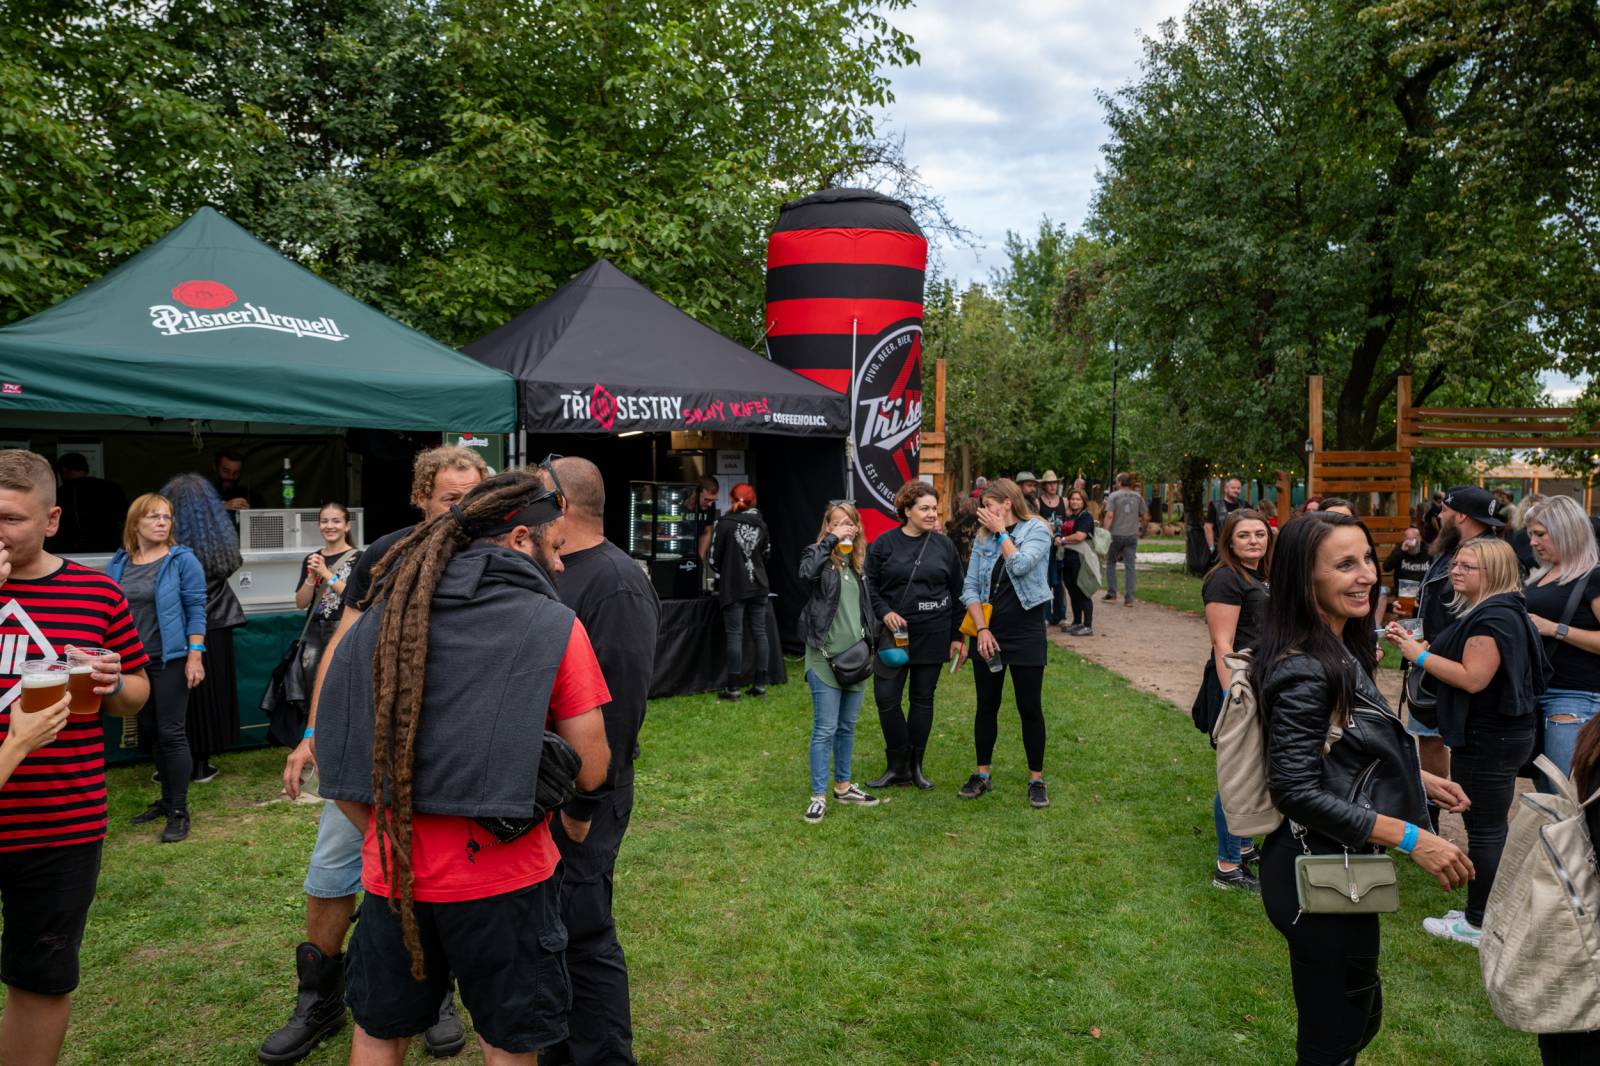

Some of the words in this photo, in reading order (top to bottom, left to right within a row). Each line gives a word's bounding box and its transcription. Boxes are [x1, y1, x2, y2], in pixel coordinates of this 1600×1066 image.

[149, 304, 252, 336] Pilsner
[244, 302, 347, 338] Urquell
[864, 361, 883, 384] PIVO,
[877, 342, 898, 362] BEER,
[560, 390, 592, 419] TŘI
[616, 395, 682, 420] SESTRY
[865, 463, 879, 484] EST.
